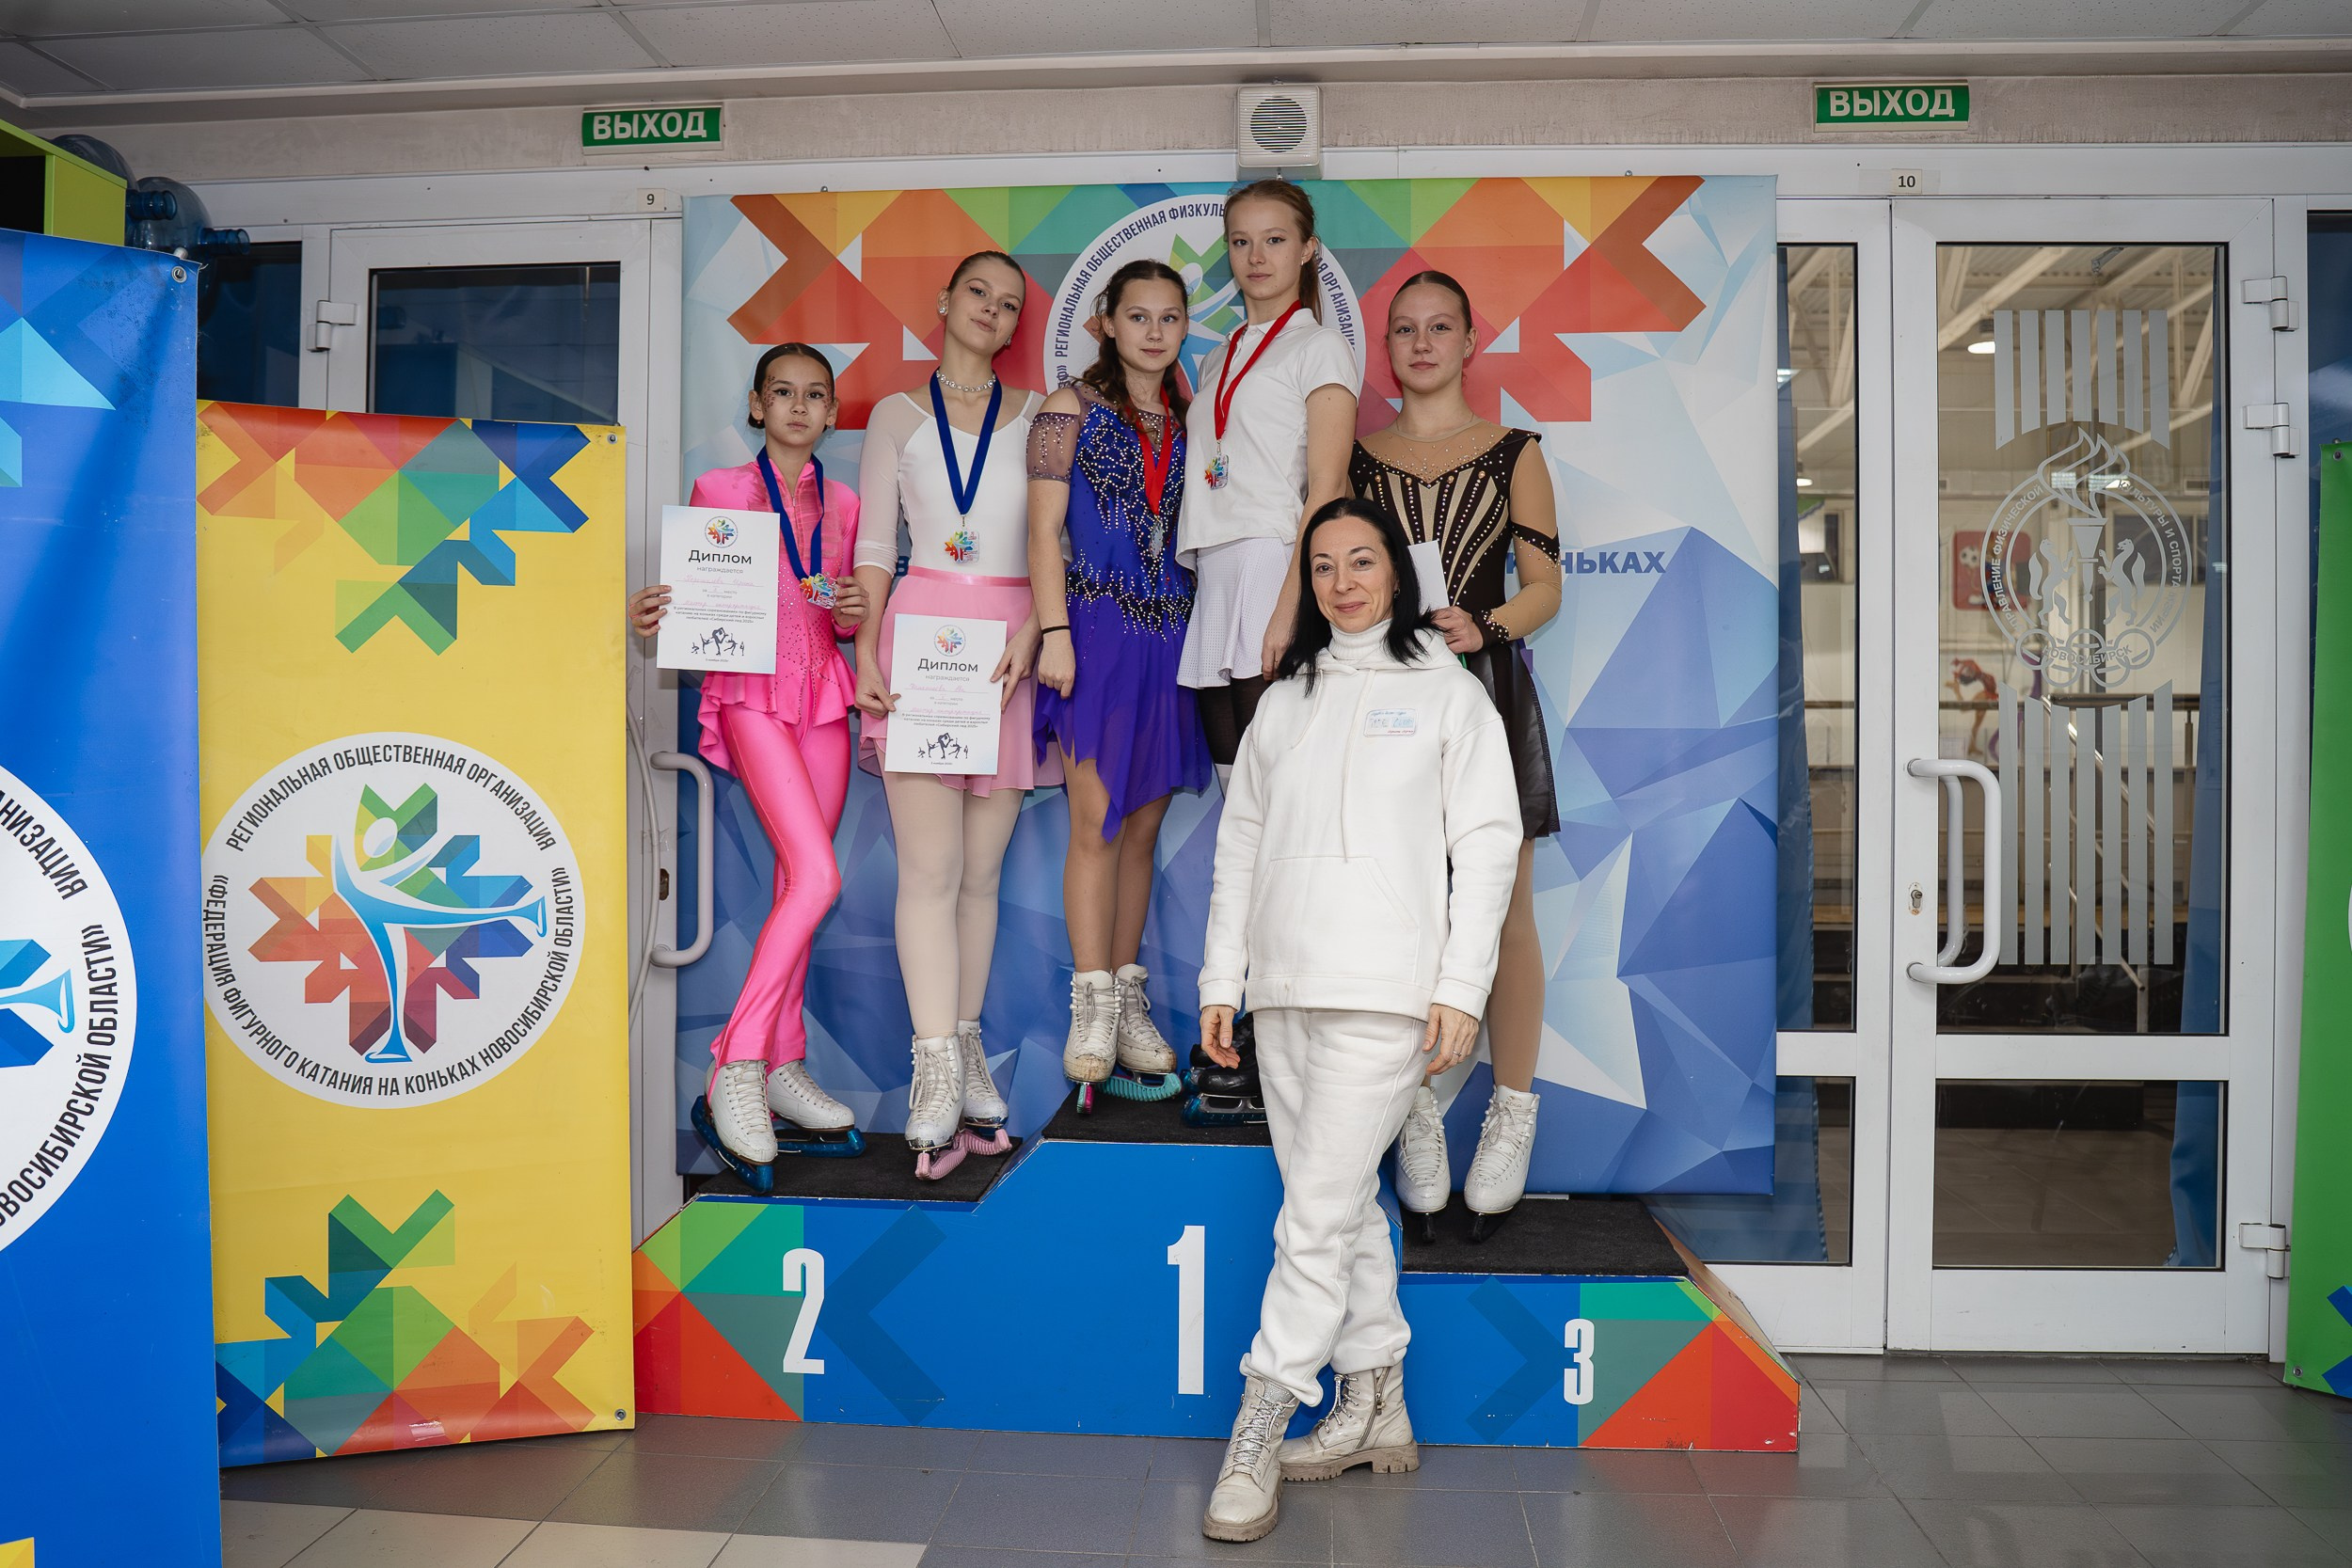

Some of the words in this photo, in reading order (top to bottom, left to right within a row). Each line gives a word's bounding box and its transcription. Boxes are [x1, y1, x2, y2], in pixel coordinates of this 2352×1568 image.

[593, 111, 707, 140] ВЫХОД
[1829, 88, 1955, 118] ВЫХОД
[646, 193, 655, 205] 9
[1898, 175, 1916, 188] 10
[1054, 270, 1092, 357] РЕГИОНАЛЬНАЯ
[1086, 210, 1168, 275] ОБЩЕСТВЕННАЯ
[1993, 484, 2043, 555] ФИЗИЧЕСКОЙ
[2118, 480, 2169, 527] КУЛЬТУРЫ
[689, 549, 752, 564] Диплом
[2165, 529, 2175, 538] И
[2169, 540, 2182, 588] СПОРТА
[917, 658, 978, 673] Диплом
[226, 757, 332, 852] РЕГИОНАЛЬНАЯ
[335, 744, 467, 775] ОБЩЕСТВЕННАЯ
[466, 763, 557, 851] ОРГАНИЗАЦИЯ
[81, 924, 119, 1046] ОБЛАСТИ»
[202, 875, 236, 988] «ФЕДЕРАЦИЯ
[223, 988, 301, 1069] ФИГУРНОГО
[295, 1056, 373, 1096] КАТАНИЯ
[377, 1077, 400, 1097] НА
[405, 1057, 481, 1096] КОНЬКАХ
[477, 954, 570, 1069] НОВОСИБИРСКОЙ
[551, 866, 575, 948] ОБЛАСТИ»
[783, 1247, 825, 1375] 2
[1168, 1225, 1205, 1395] 1
[1564, 1318, 1595, 1405] 3
